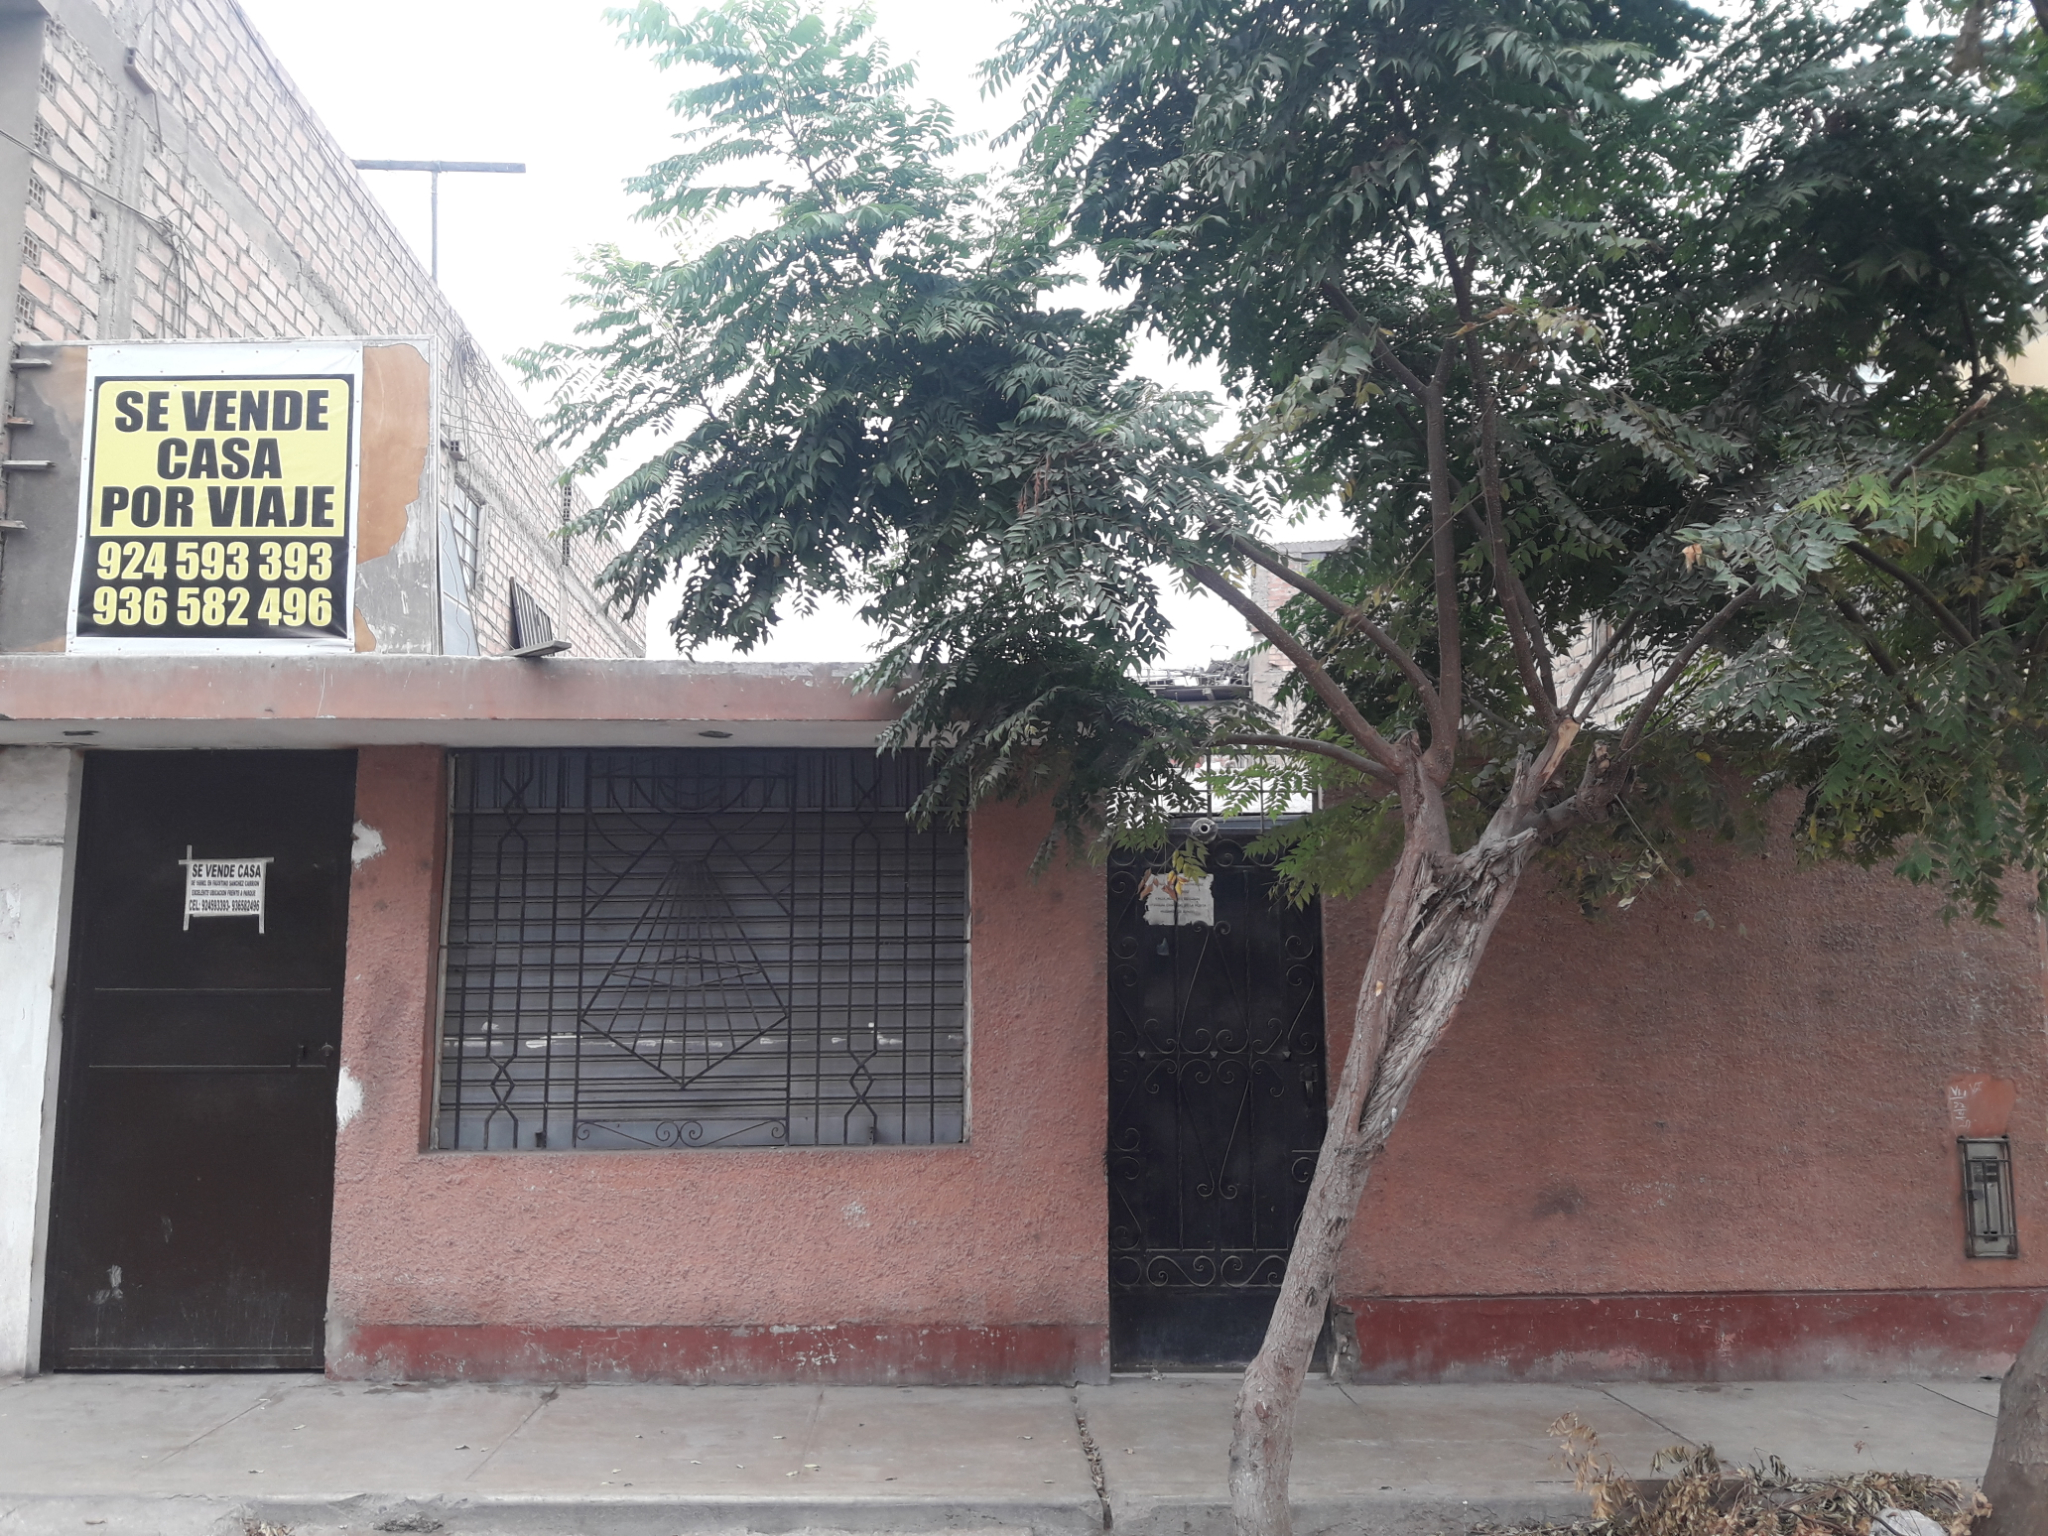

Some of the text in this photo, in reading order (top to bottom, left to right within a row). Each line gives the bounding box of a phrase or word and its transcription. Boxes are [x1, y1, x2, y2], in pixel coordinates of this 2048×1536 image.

[114, 389, 329, 432] SE VENDE
[157, 437, 283, 480] CASA
[100, 485, 335, 528] POR VIAJE
[96, 541, 332, 581] 924 593 393
[93, 586, 332, 627] 936 582 496
[192, 864, 261, 878] SE VENDE CASA
[189, 899, 201, 911] CEL:
[232, 899, 260, 912] 936582496
